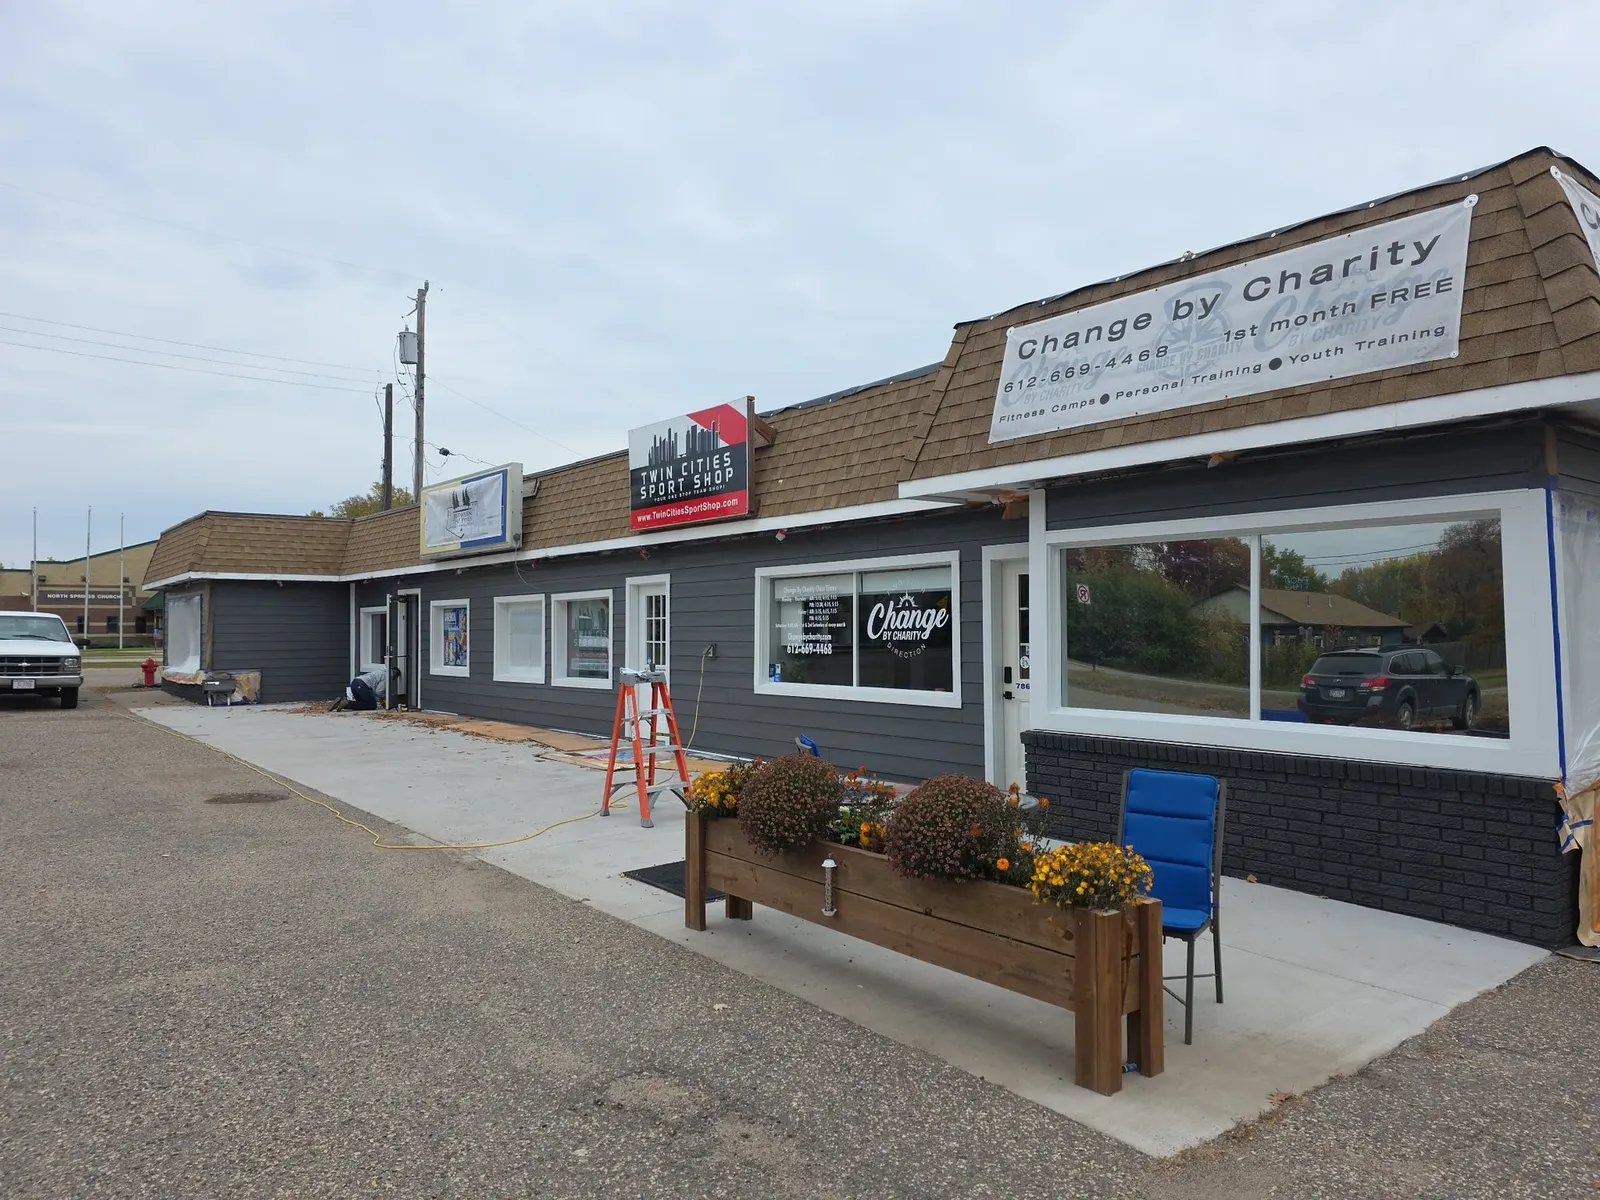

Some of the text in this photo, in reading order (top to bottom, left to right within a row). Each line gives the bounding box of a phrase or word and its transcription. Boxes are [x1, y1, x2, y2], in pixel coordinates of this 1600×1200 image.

[1018, 234, 1441, 360] Change by Charity
[1224, 277, 1453, 342] 1st month FREE
[999, 325, 1446, 424] Fitness Camps Personal Training Youth Training
[1004, 345, 1169, 393] 612-669-4468
[640, 467, 734, 499] SPORT SHOP
[641, 452, 731, 485] TWIN CITIES
[693, 487, 706, 495] TEAM
[637, 498, 738, 522] www.TwinCitiesSportShop.com
[867, 600, 949, 639] Change
[882, 630, 921, 640] BY CHARITY
[787, 643, 832, 655] 612-669-4468
[887, 642, 926, 658] DIRECTION
